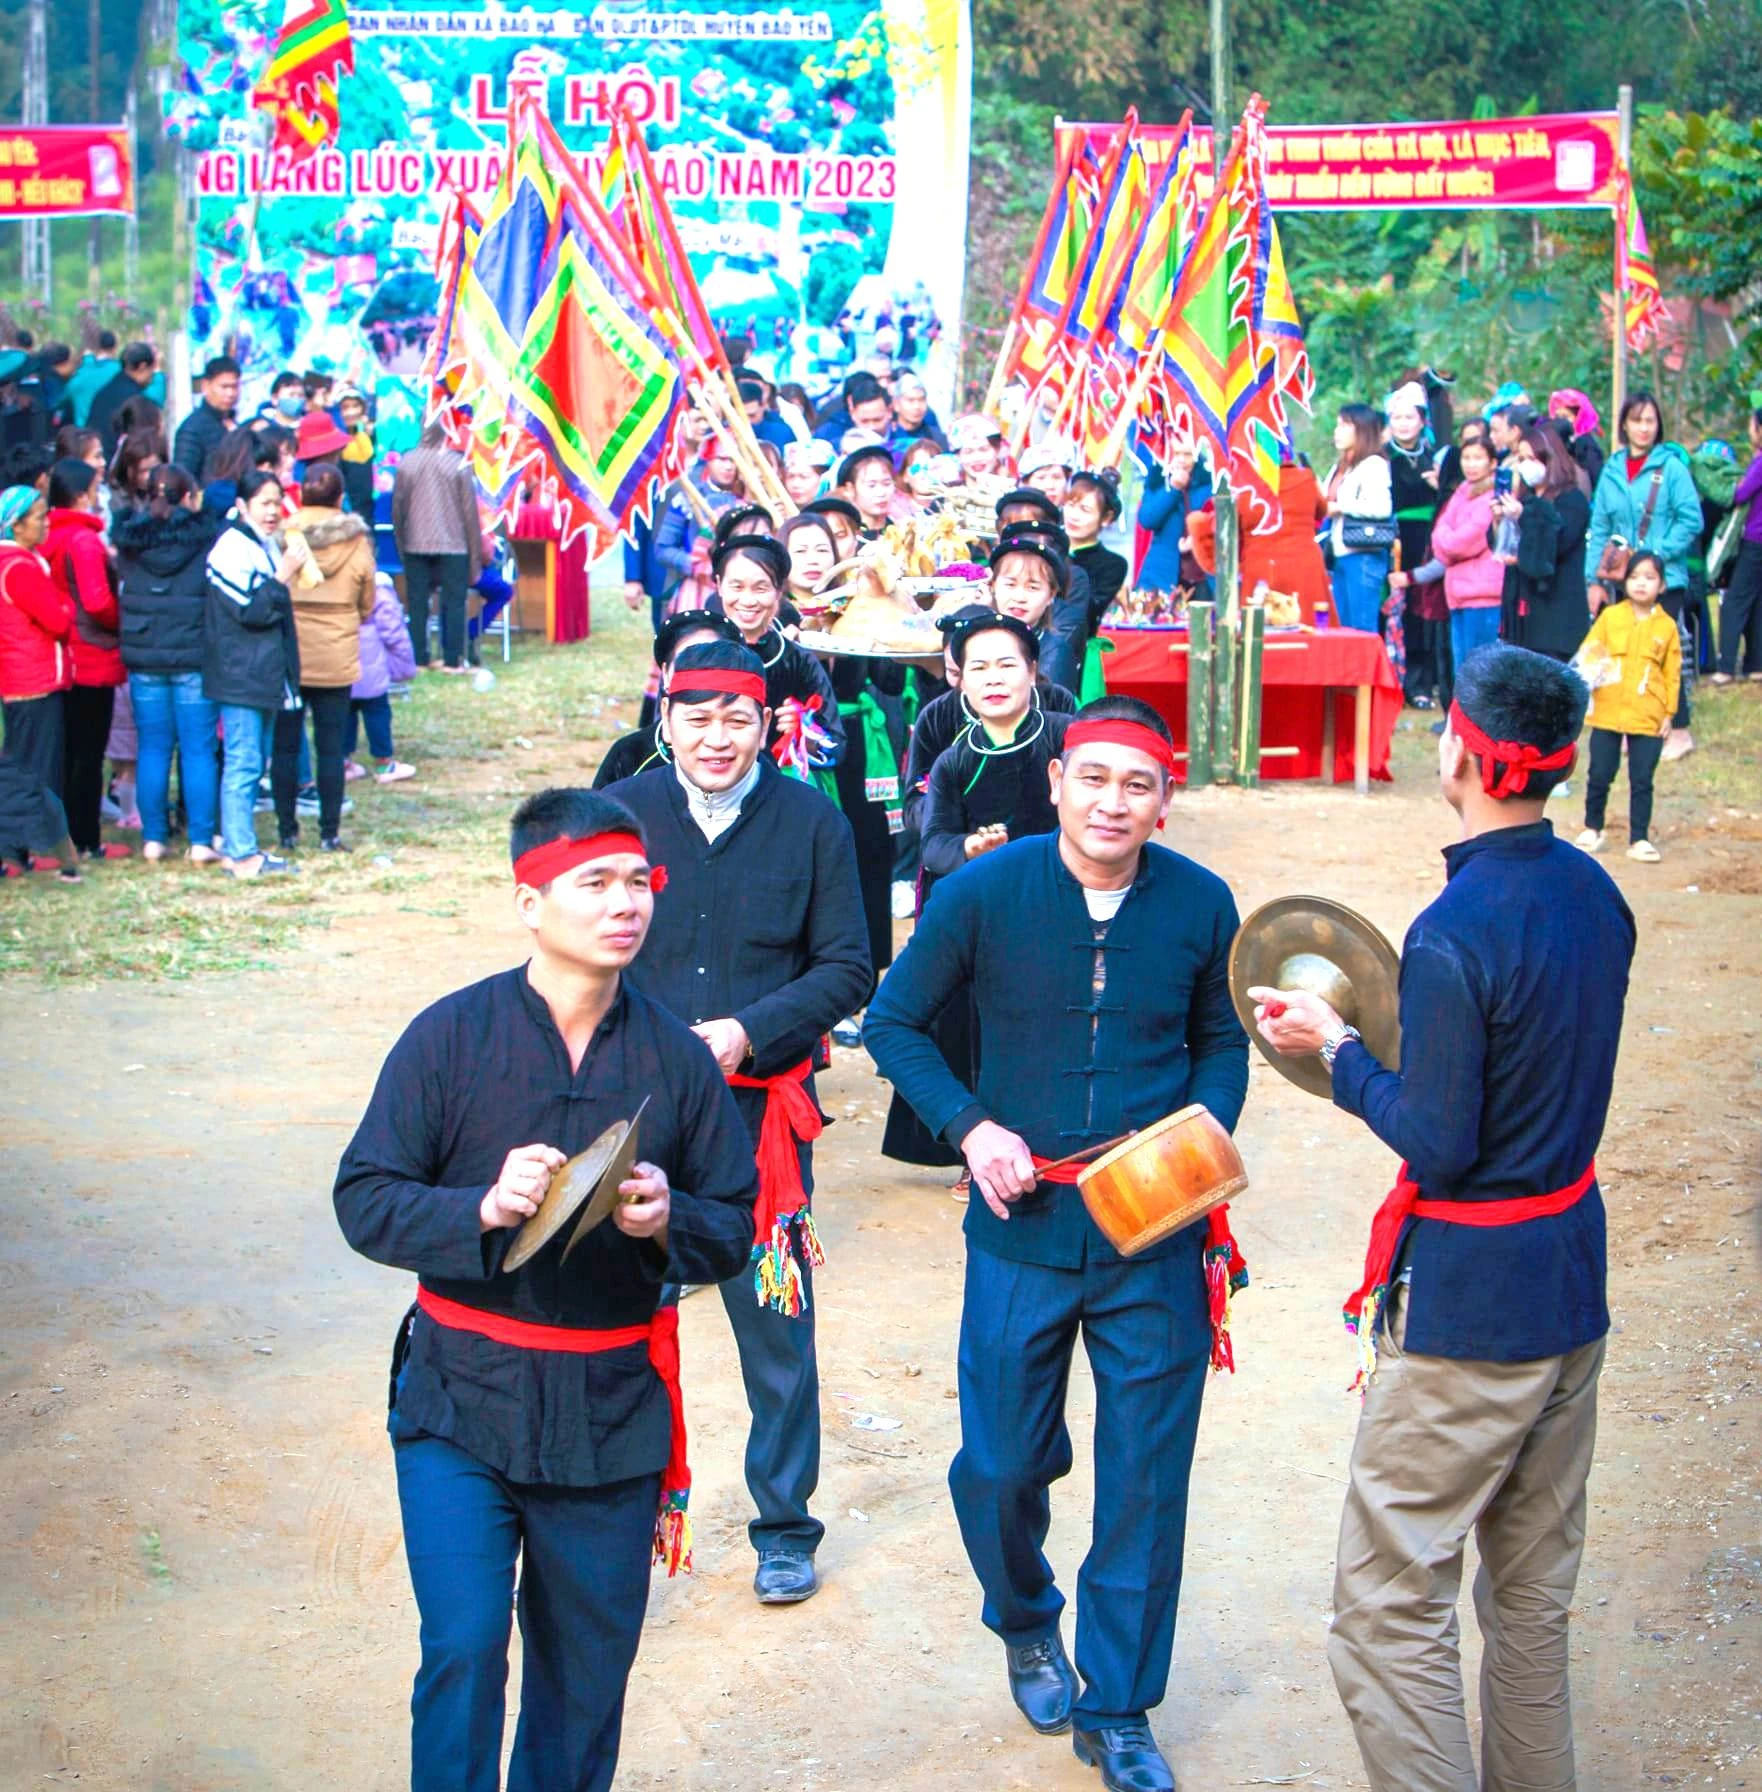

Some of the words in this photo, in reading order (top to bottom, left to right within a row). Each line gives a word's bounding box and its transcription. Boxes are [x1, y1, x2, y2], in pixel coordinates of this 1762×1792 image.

[356, 145, 420, 193] LÚC
[435, 147, 501, 193] XUÂ
[814, 160, 896, 198] 2023
